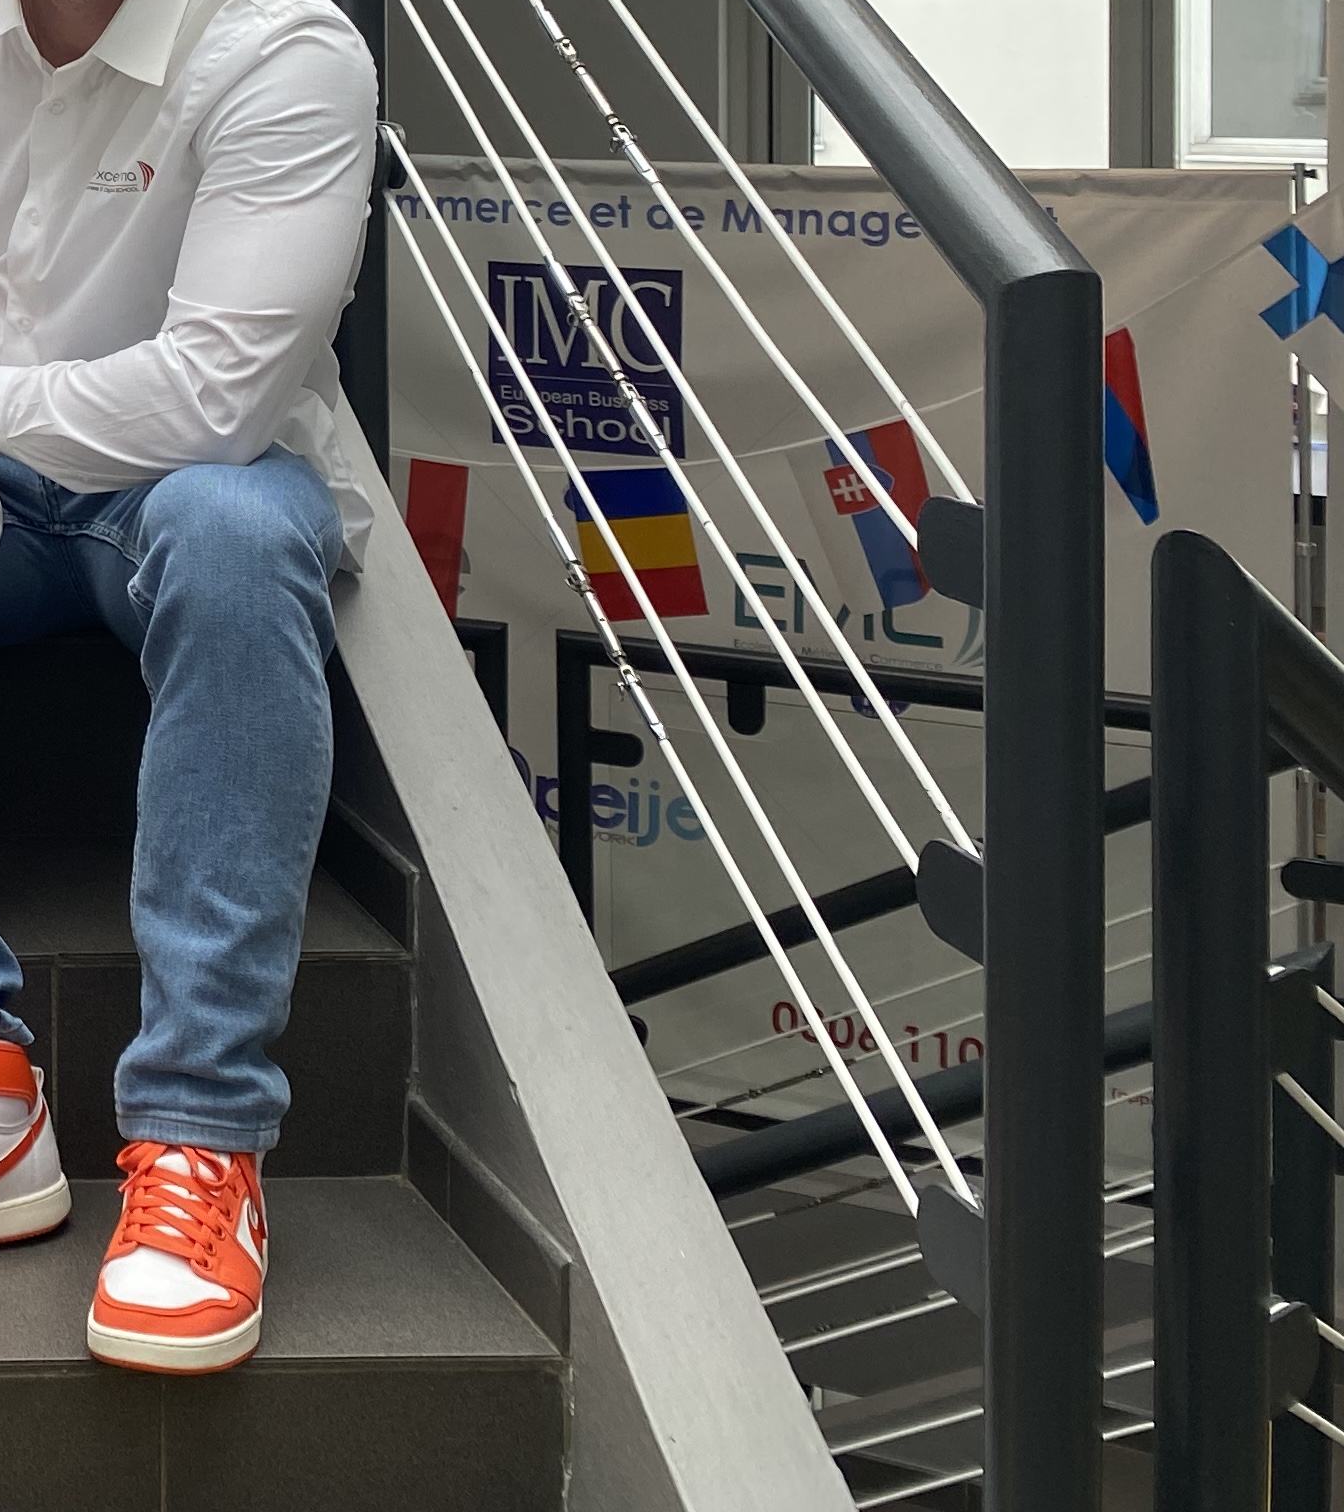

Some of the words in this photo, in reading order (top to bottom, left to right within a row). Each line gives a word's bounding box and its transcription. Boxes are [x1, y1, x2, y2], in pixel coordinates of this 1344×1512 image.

[393, 193, 572, 227] mmerce
[589, 194, 632, 229] et
[721, 199, 924, 248] Manage
[496, 274, 673, 373] IMC
